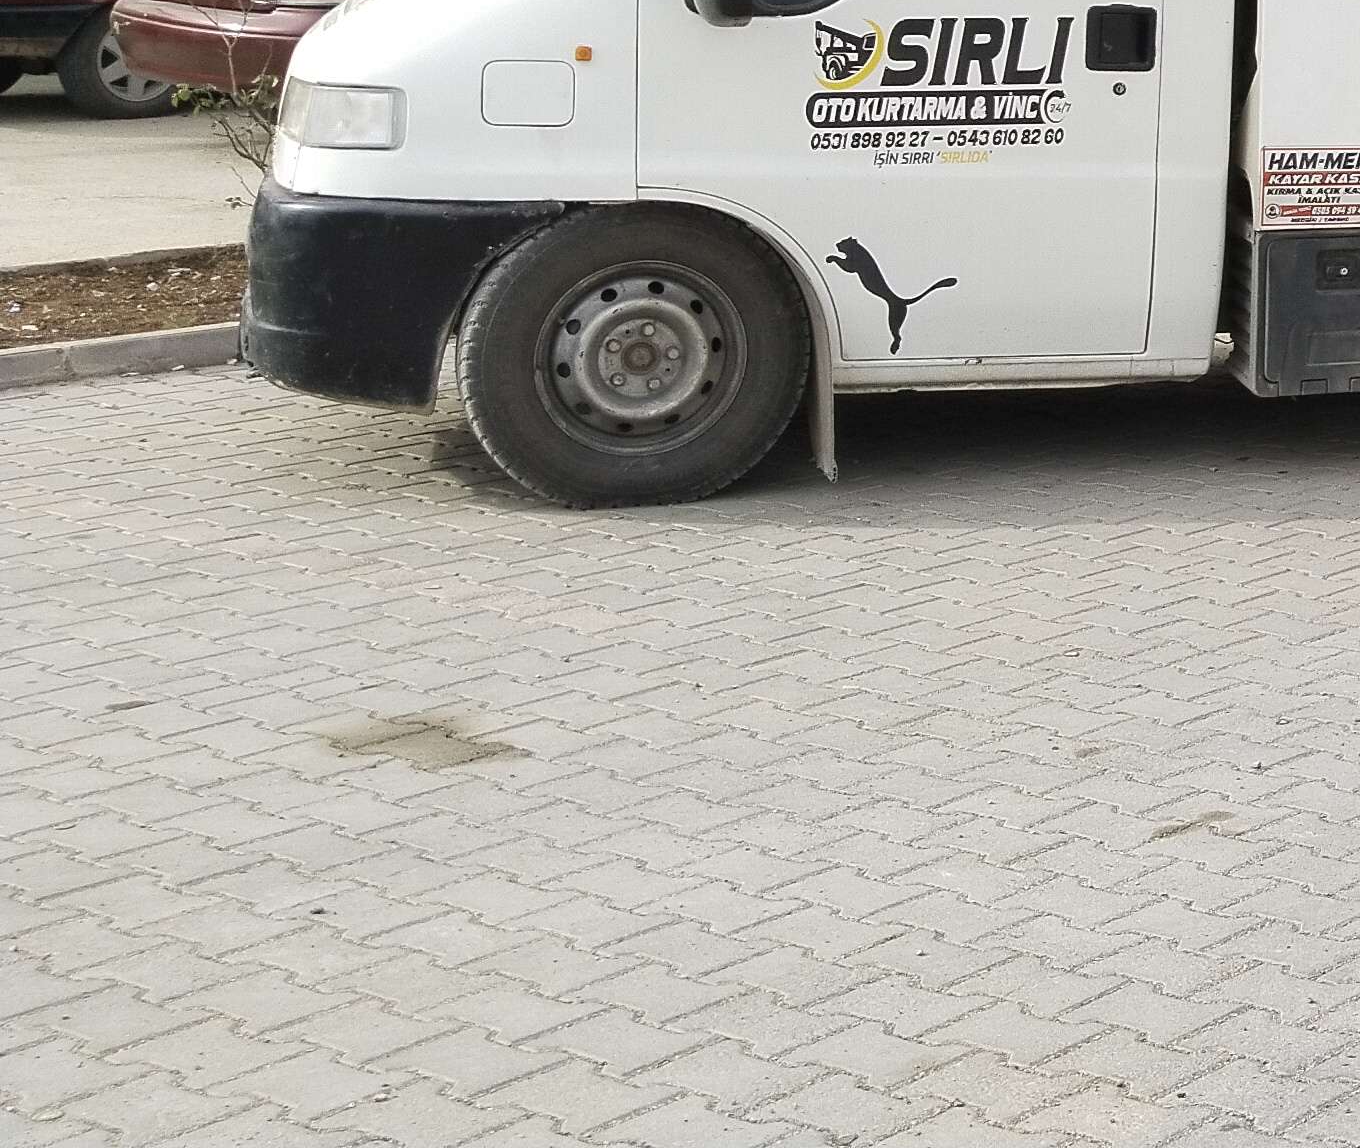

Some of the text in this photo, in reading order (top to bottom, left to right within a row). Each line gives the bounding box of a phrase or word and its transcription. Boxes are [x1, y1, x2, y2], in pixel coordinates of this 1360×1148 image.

[880, 16, 1075, 87] SIRLI
[812, 97, 856, 123] OTO
[856, 95, 966, 122] KURTARMA
[970, 95, 988, 120] &
[810, 132, 849, 150] 0531
[850, 131, 882, 149] 898
[885, 130, 906, 148] 92
[908, 130, 930, 148] 27
[1020, 128, 1042, 145] 82
[900, 151, 934, 165] SIRRI
[1268, 173, 1323, 186] KAYAR
